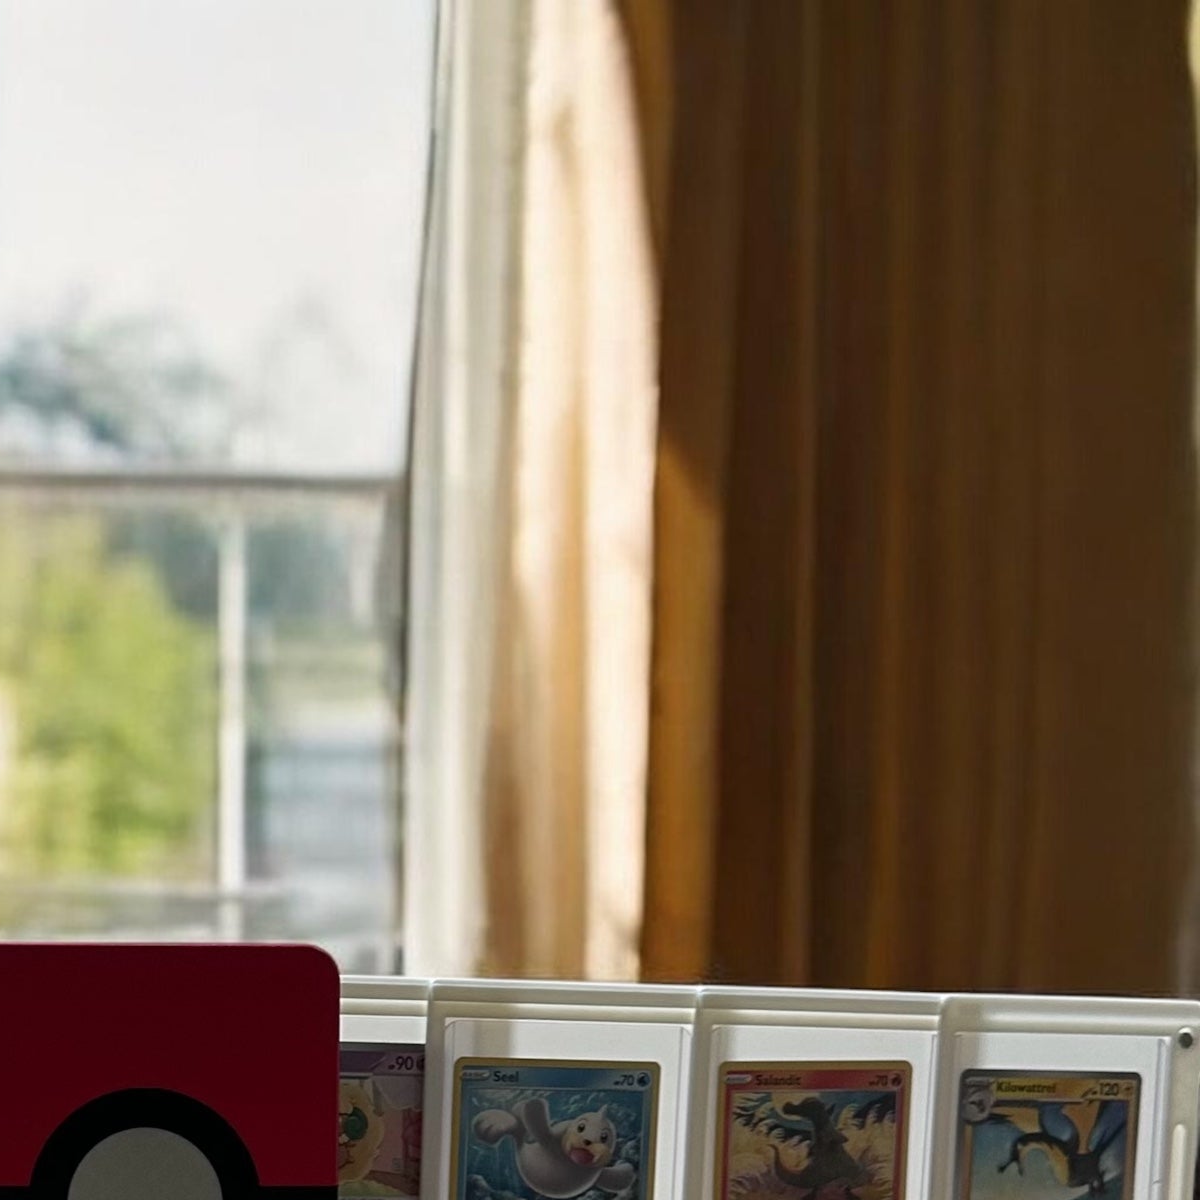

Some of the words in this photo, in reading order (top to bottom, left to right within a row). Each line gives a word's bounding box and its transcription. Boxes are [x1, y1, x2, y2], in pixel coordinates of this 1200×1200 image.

[395, 1055, 414, 1071] 90
[493, 1071, 520, 1083] Seel
[620, 1074, 635, 1086] 70
[1099, 1082, 1119, 1096] 120
